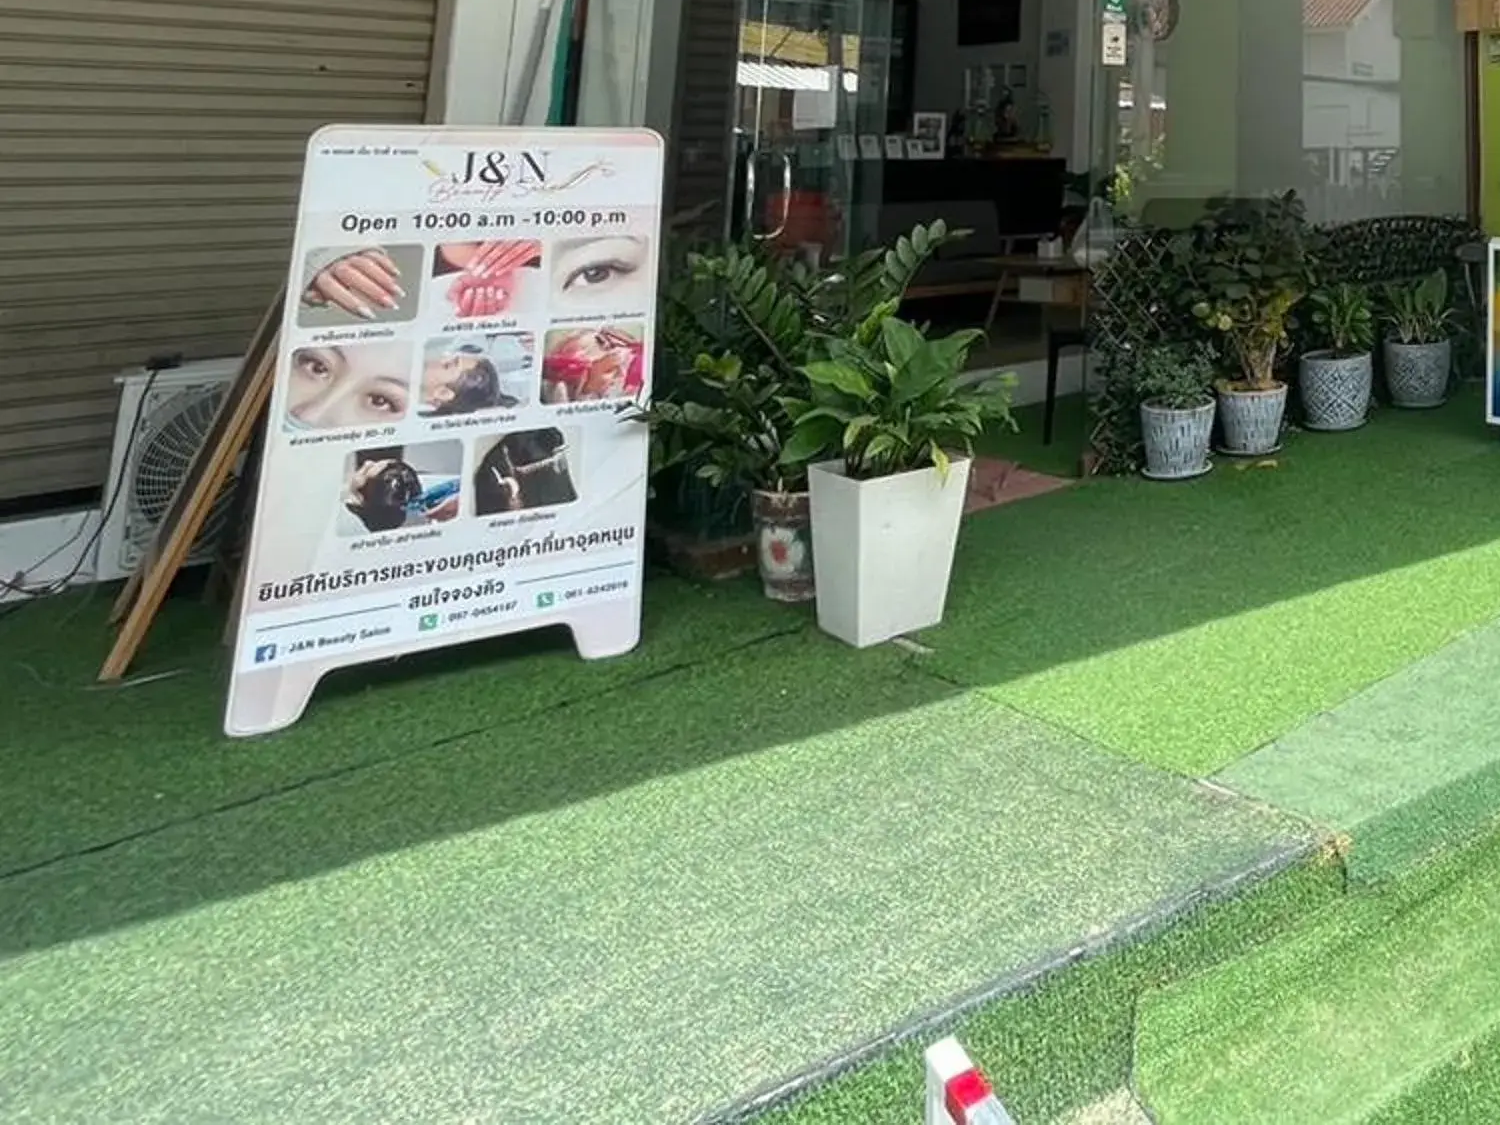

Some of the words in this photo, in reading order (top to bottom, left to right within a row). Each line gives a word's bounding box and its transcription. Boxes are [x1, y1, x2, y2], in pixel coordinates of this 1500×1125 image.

[452, 150, 550, 187] J&N
[341, 214, 397, 234] Open
[412, 212, 471, 229] 10:00
[476, 211, 515, 228] a.m
[591, 210, 626, 227] p.m
[408, 578, 505, 610] สนใจจองคิว
